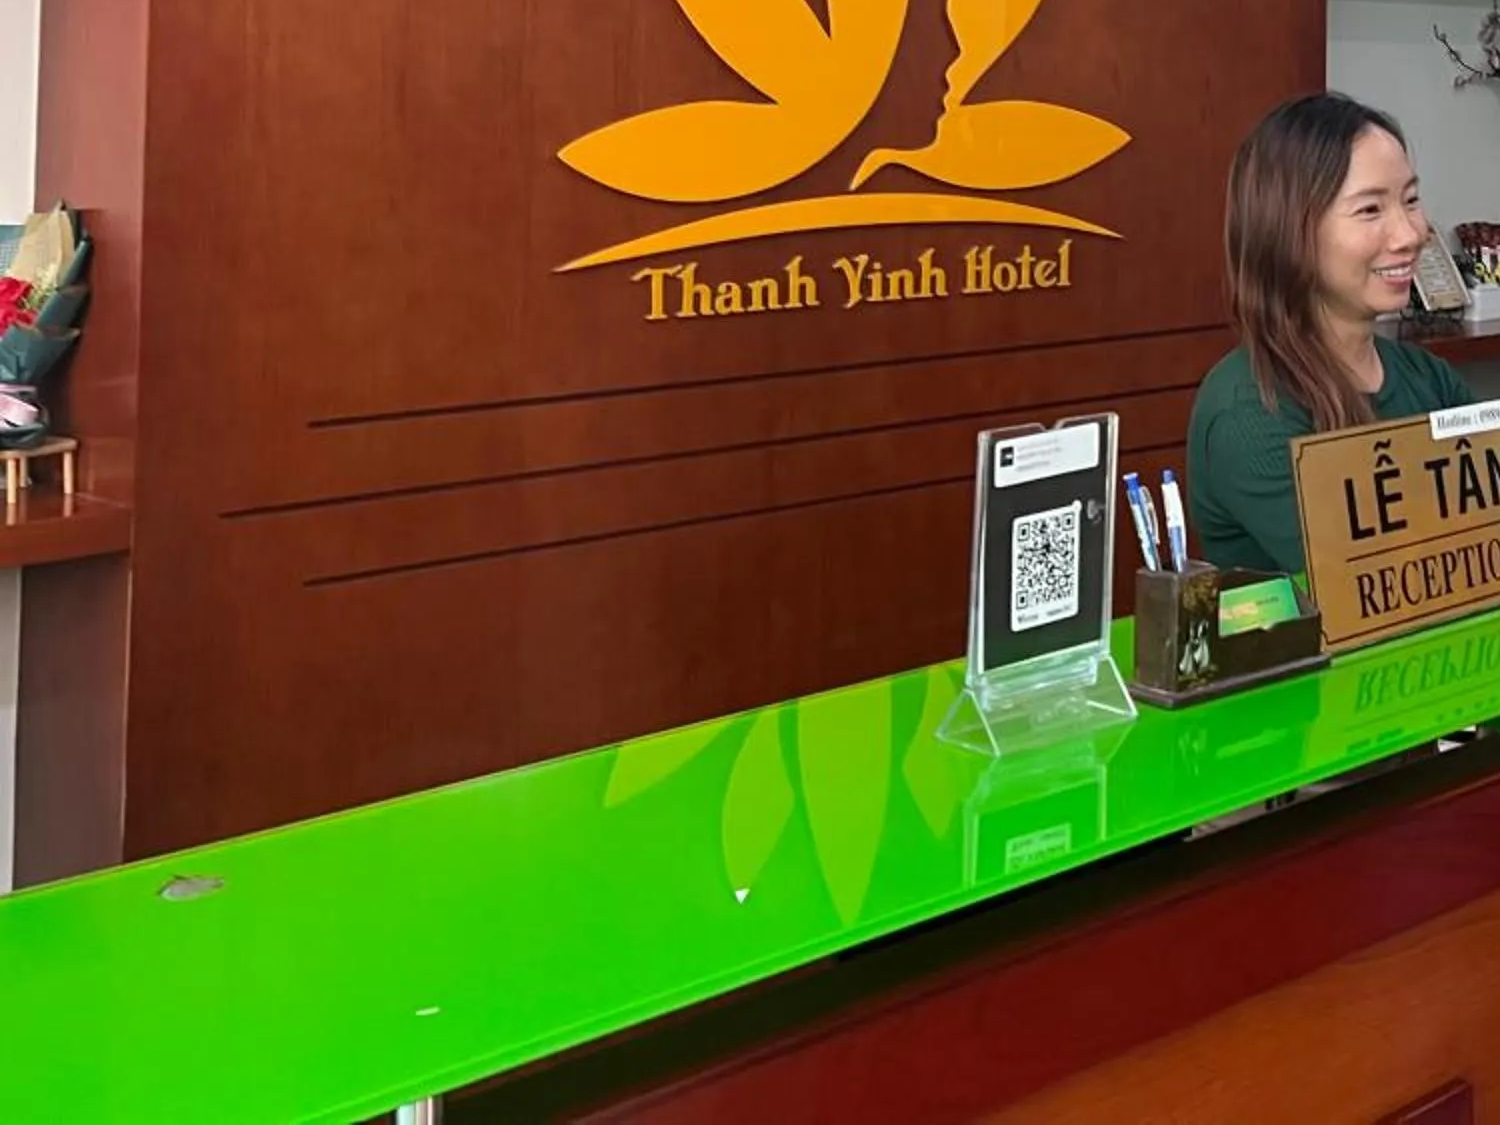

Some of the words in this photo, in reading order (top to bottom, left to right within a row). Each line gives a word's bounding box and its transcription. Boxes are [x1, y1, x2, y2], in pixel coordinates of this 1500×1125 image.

[630, 255, 821, 321] Thanh
[962, 237, 1074, 295] Hotel
[1343, 437, 1408, 541] LỄ
